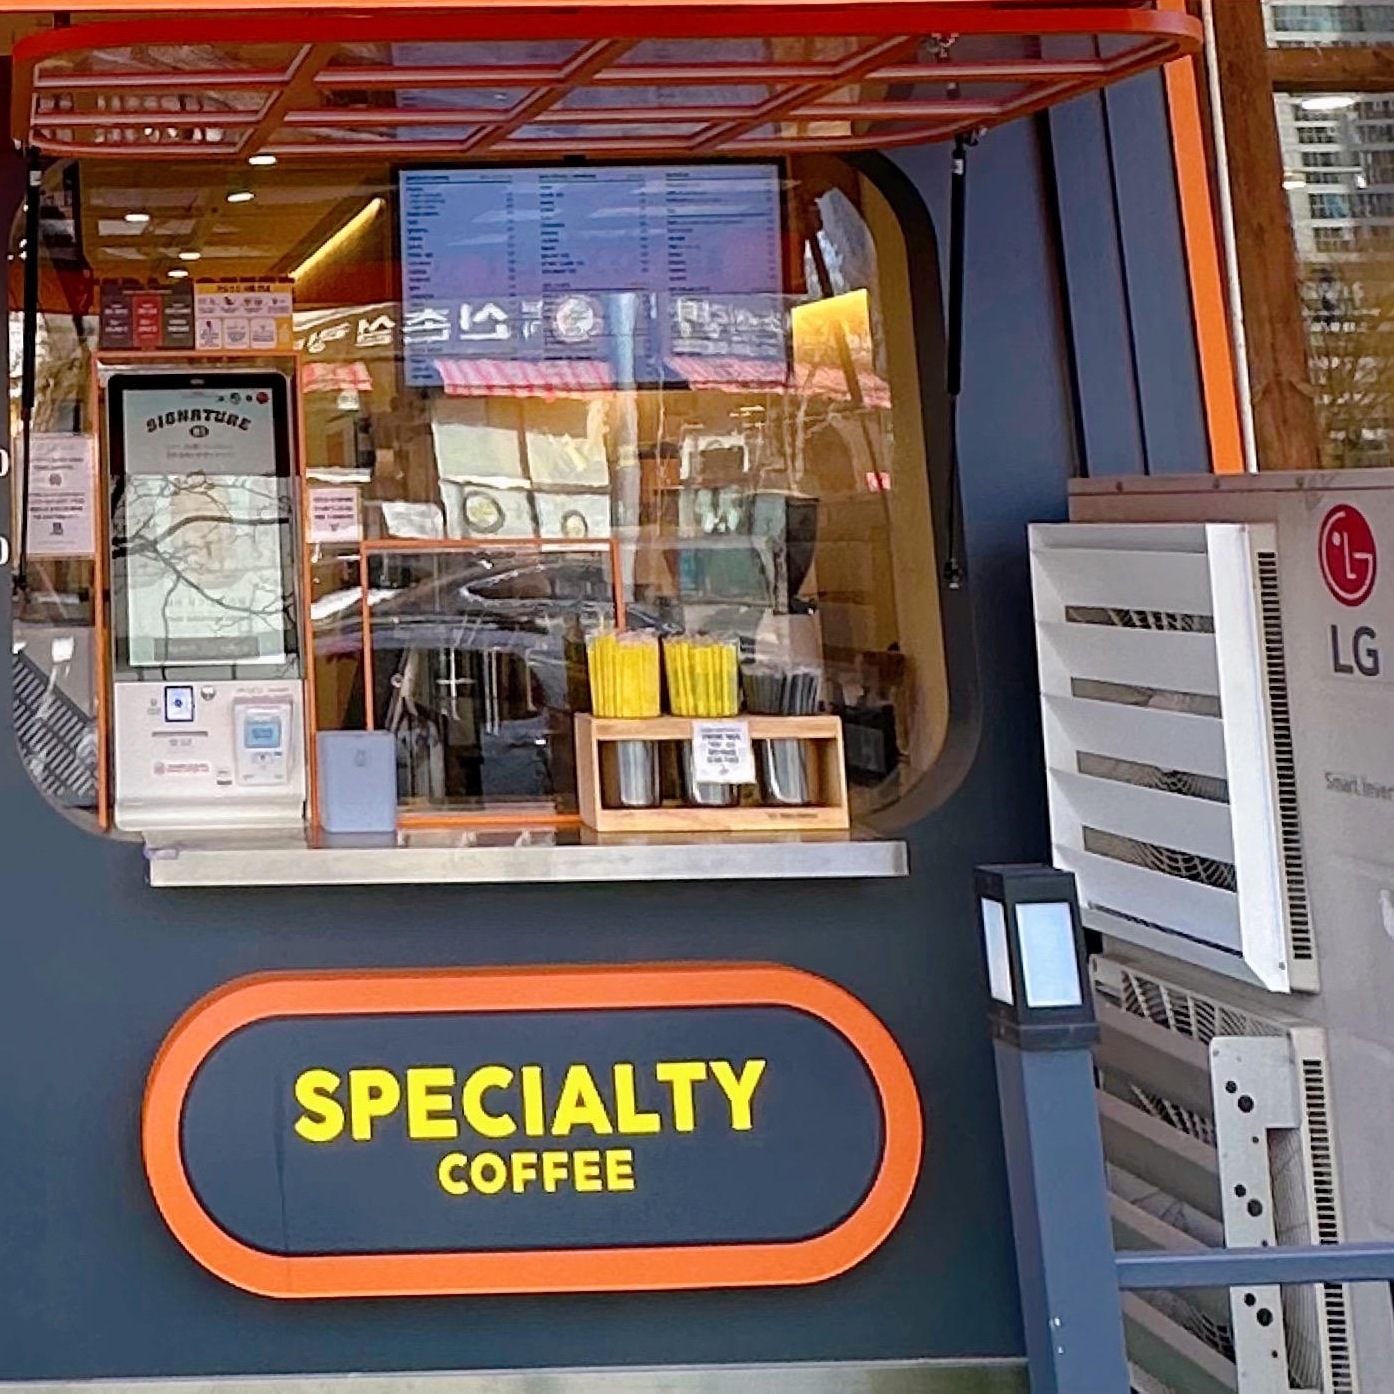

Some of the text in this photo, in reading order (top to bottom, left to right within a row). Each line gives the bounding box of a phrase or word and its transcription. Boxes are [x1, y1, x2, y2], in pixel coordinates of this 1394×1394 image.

[1330, 624, 1380, 677] LG
[294, 1058, 766, 1142] SPECIALTY
[438, 1149, 636, 1196] COFFEE
